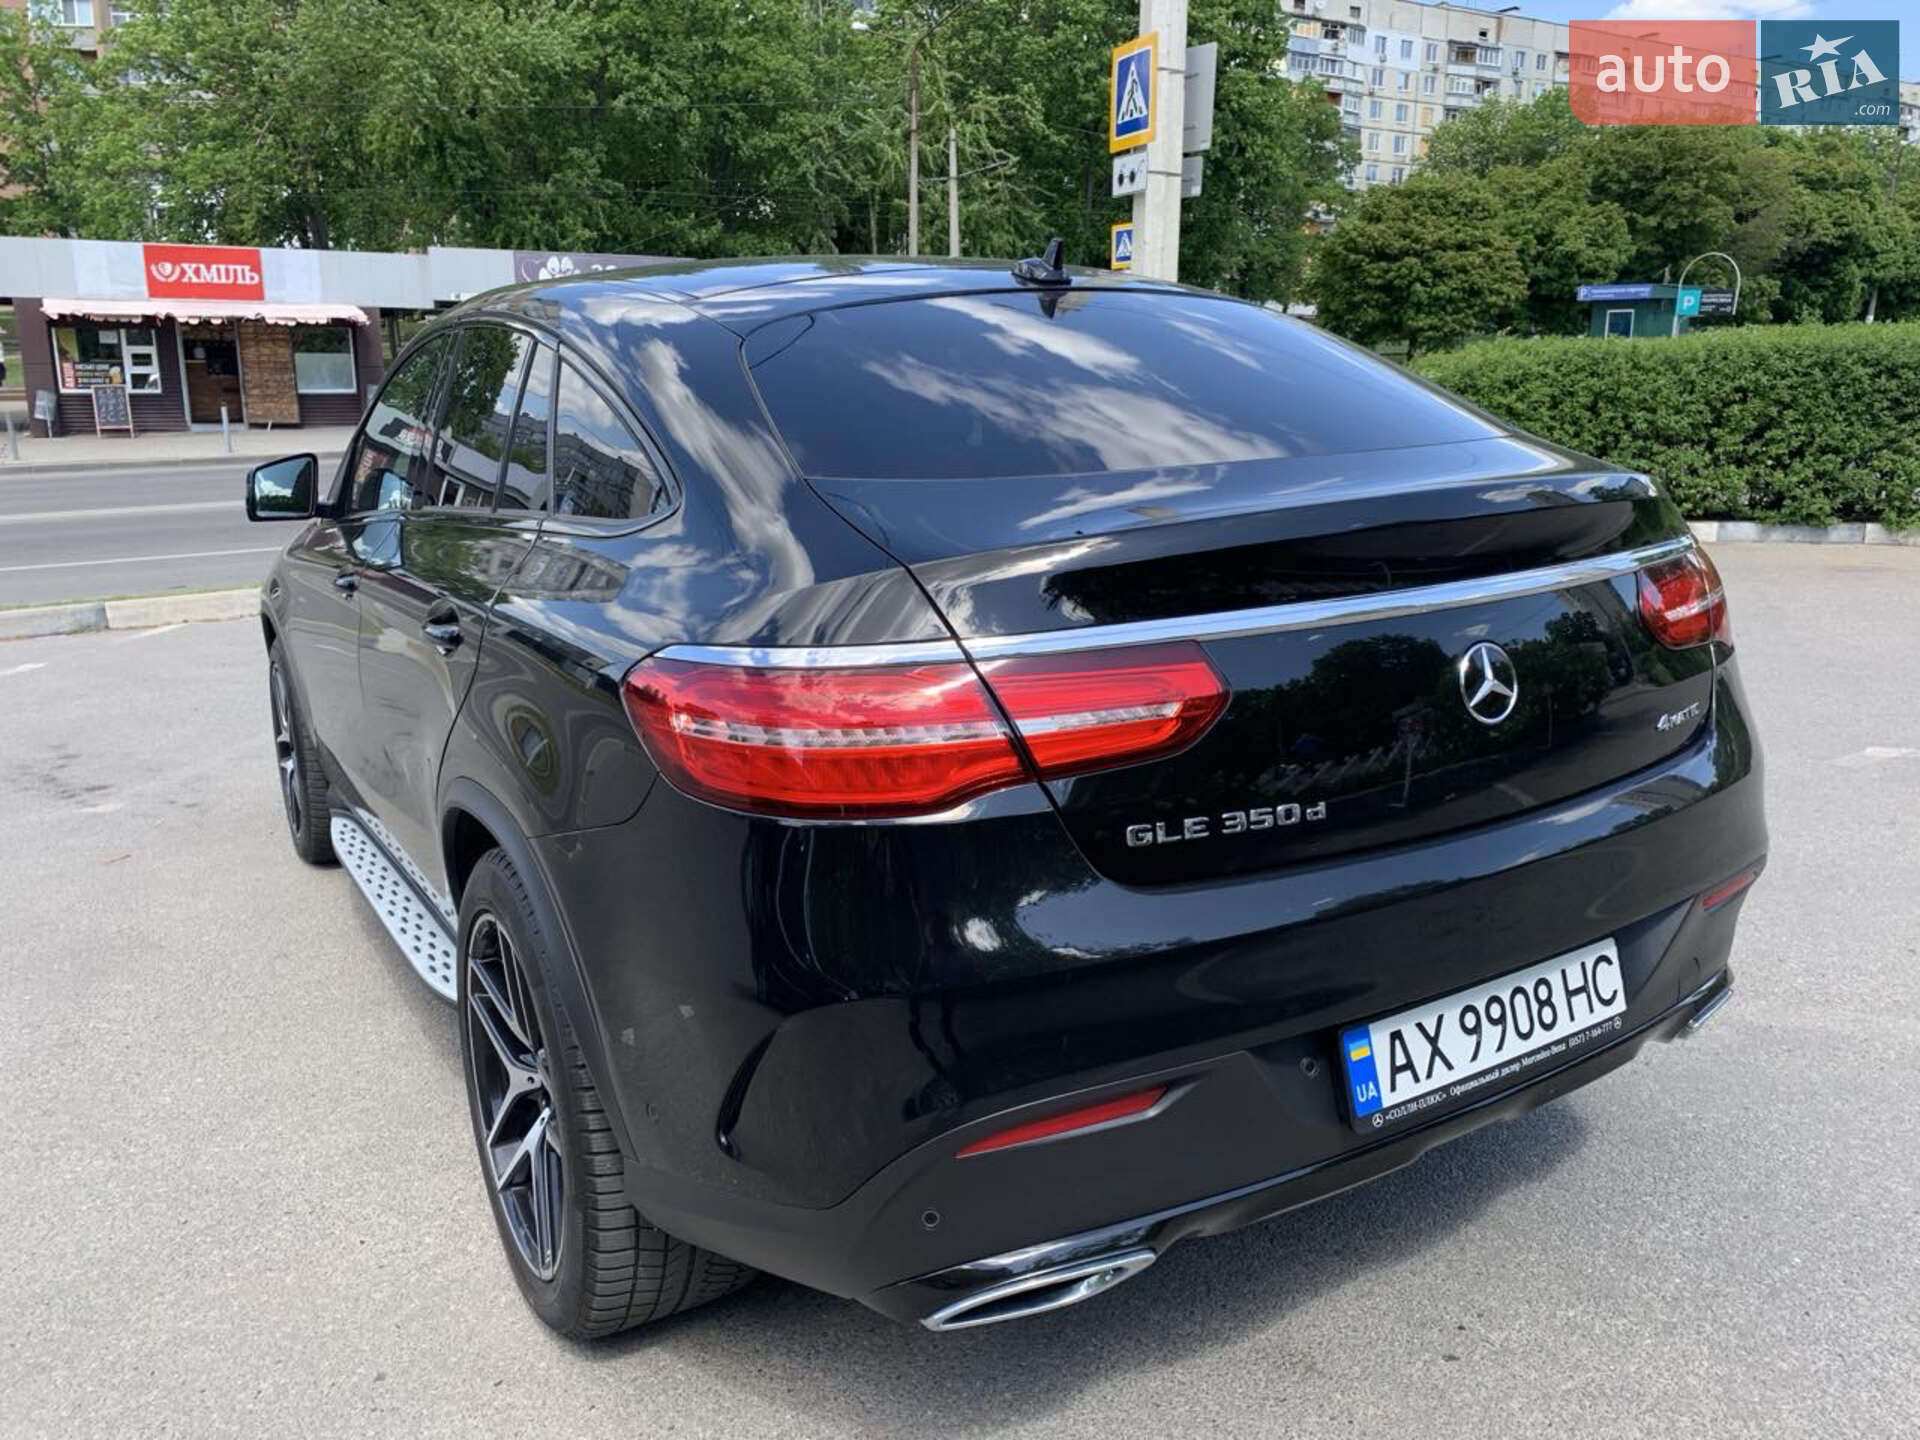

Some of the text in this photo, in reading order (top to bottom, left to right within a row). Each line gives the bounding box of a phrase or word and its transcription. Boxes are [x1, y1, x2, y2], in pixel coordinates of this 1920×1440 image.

[181, 263, 260, 284] ХМІЛЬ
[1126, 816, 1210, 847] GLE
[1389, 954, 1619, 1094] AX 9908 HC
[1356, 1081, 1379, 1102] UA
